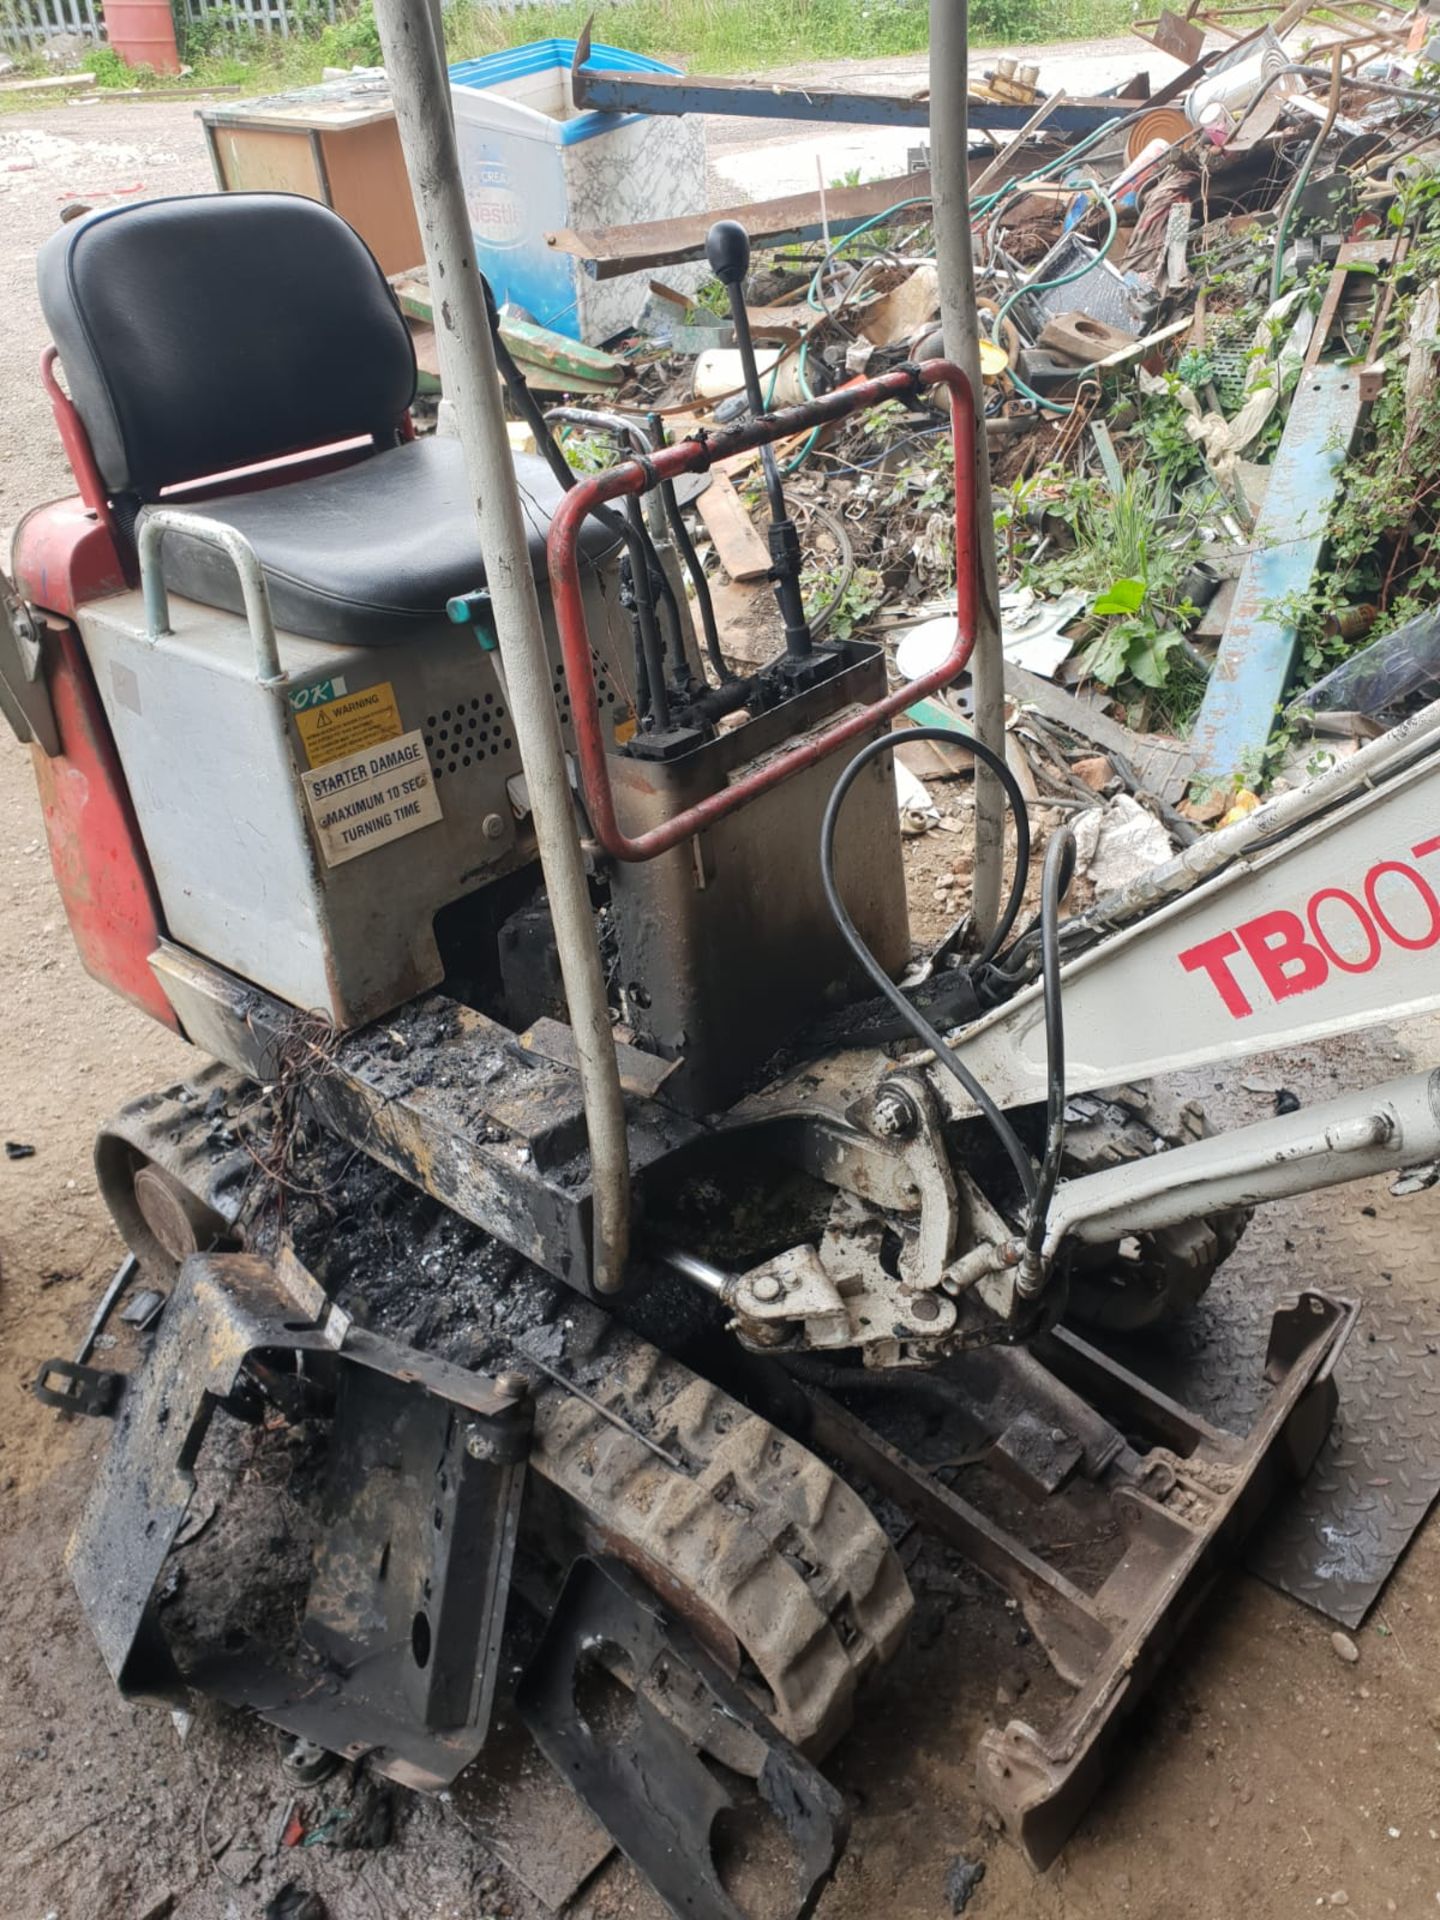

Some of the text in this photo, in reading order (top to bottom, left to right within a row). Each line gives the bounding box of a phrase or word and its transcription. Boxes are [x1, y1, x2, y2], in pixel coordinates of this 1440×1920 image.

[333, 694, 380, 718] WARNING
[312, 743, 421, 797] STARTER DAMAGE
[326, 791, 385, 826] MAXIMUM
[387, 785, 401, 801] 10
[341, 801, 422, 844] TURNING TIME
